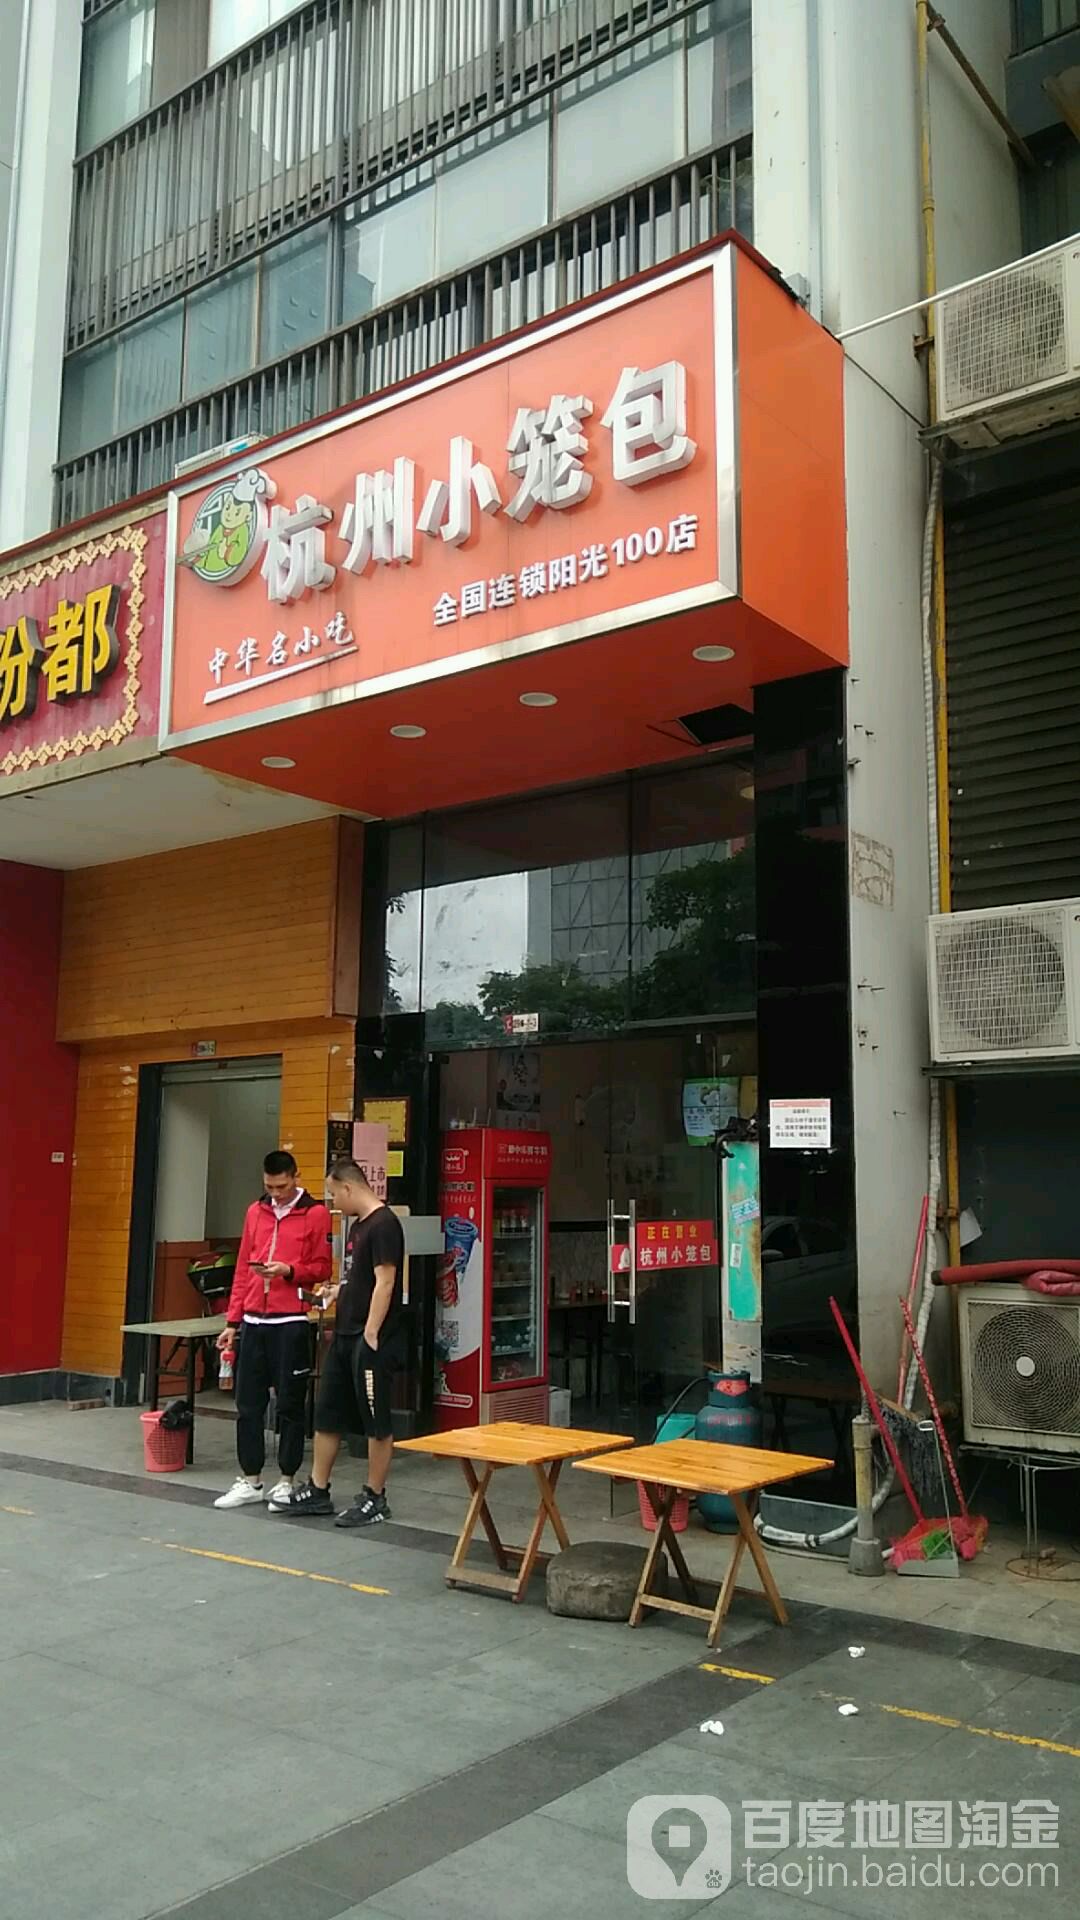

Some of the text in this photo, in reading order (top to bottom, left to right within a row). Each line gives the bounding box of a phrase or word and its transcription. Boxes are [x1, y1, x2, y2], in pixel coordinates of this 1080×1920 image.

[261, 360, 697, 604] 杭州小笼包
[433, 513, 698, 626] 全国连锁阳光100店
[208, 611, 353, 685] 中华名小吃
[640, 1243, 712, 1267] 杭州小笼包
[647, 1224, 698, 1240] 正在营业
